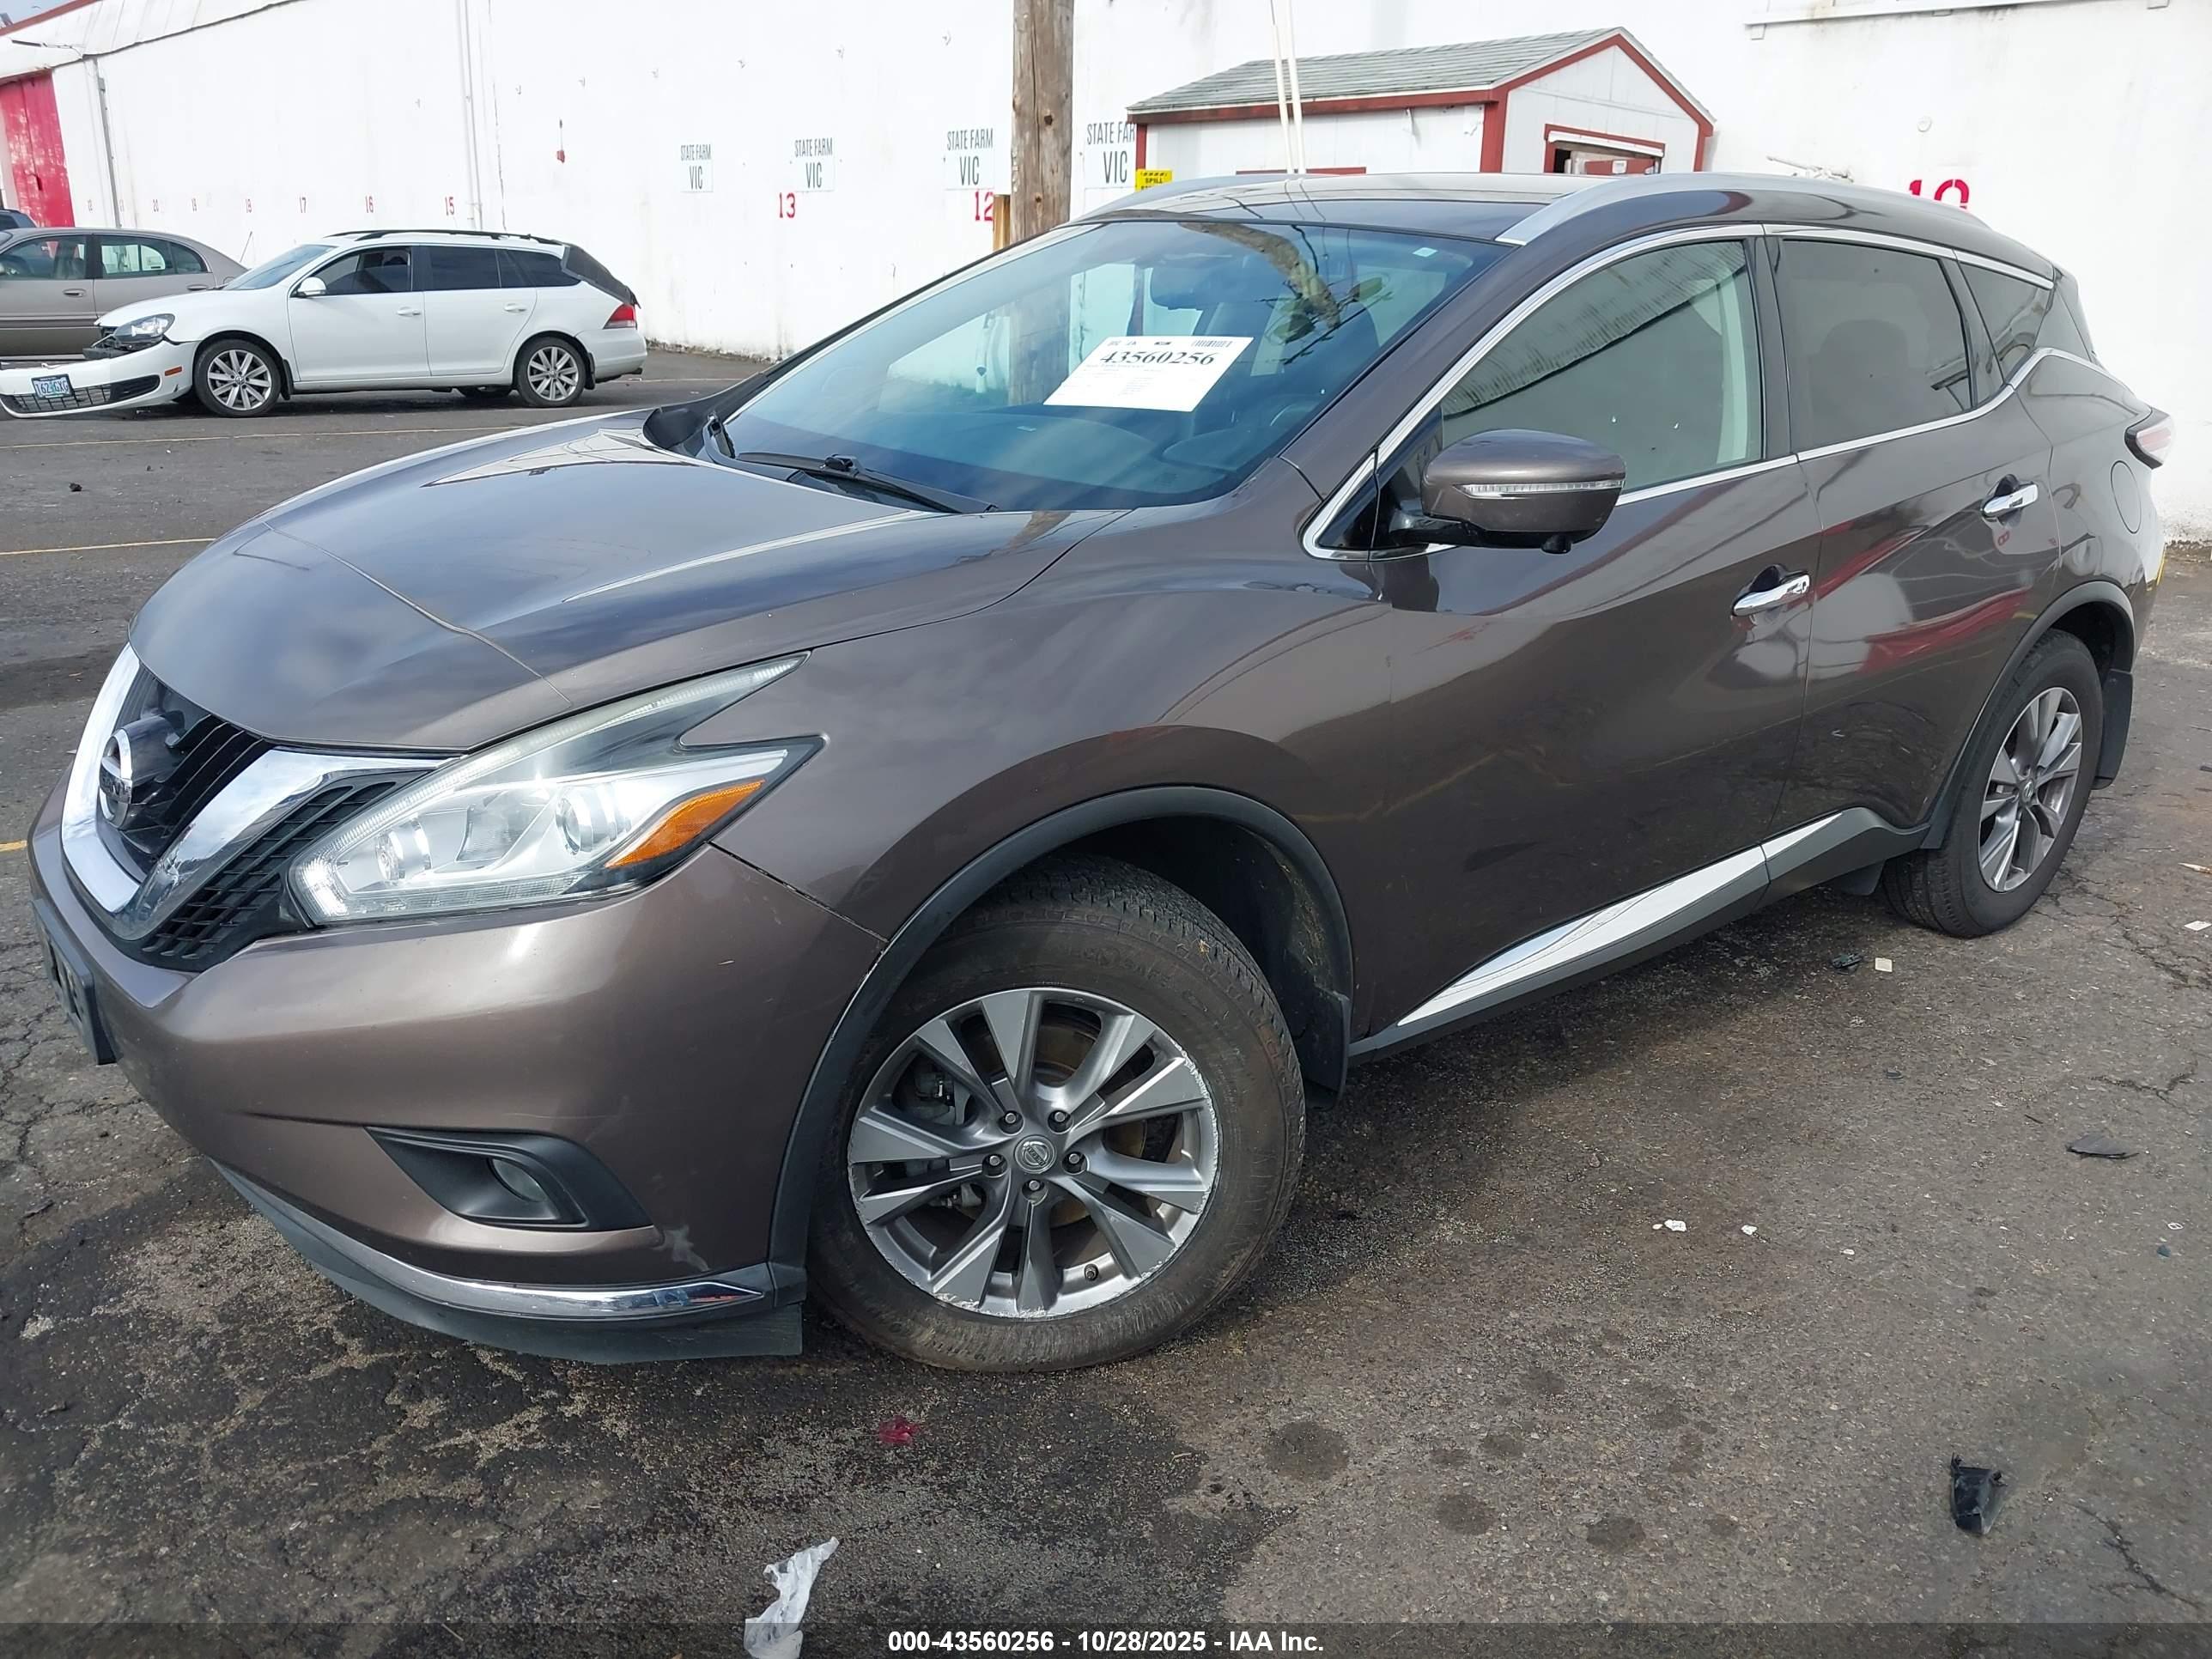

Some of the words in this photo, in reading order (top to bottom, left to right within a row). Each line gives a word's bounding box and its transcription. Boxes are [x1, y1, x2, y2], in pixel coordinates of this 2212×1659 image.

[946, 130, 967, 150] STATE
[969, 128, 993, 149] FARM
[1086, 122, 1114, 145] STATE
[1117, 121, 1134, 143] FAR
[680, 144, 695, 161] STATE
[696, 143, 711, 160] FARM
[794, 139, 812, 157] STATE
[814, 137, 833, 156] FARM
[690, 166, 703, 190] VIC
[805, 161, 823, 188] VIC
[959, 155, 980, 185] VIC
[1103, 150, 1127, 184] VIC
[300, 197, 307, 213] 17
[365, 196, 374, 213] 16
[445, 196, 454, 216] 15
[779, 191, 796, 218] 13
[975, 191, 994, 222] 12
[1101, 350, 1218, 366] 43560256
